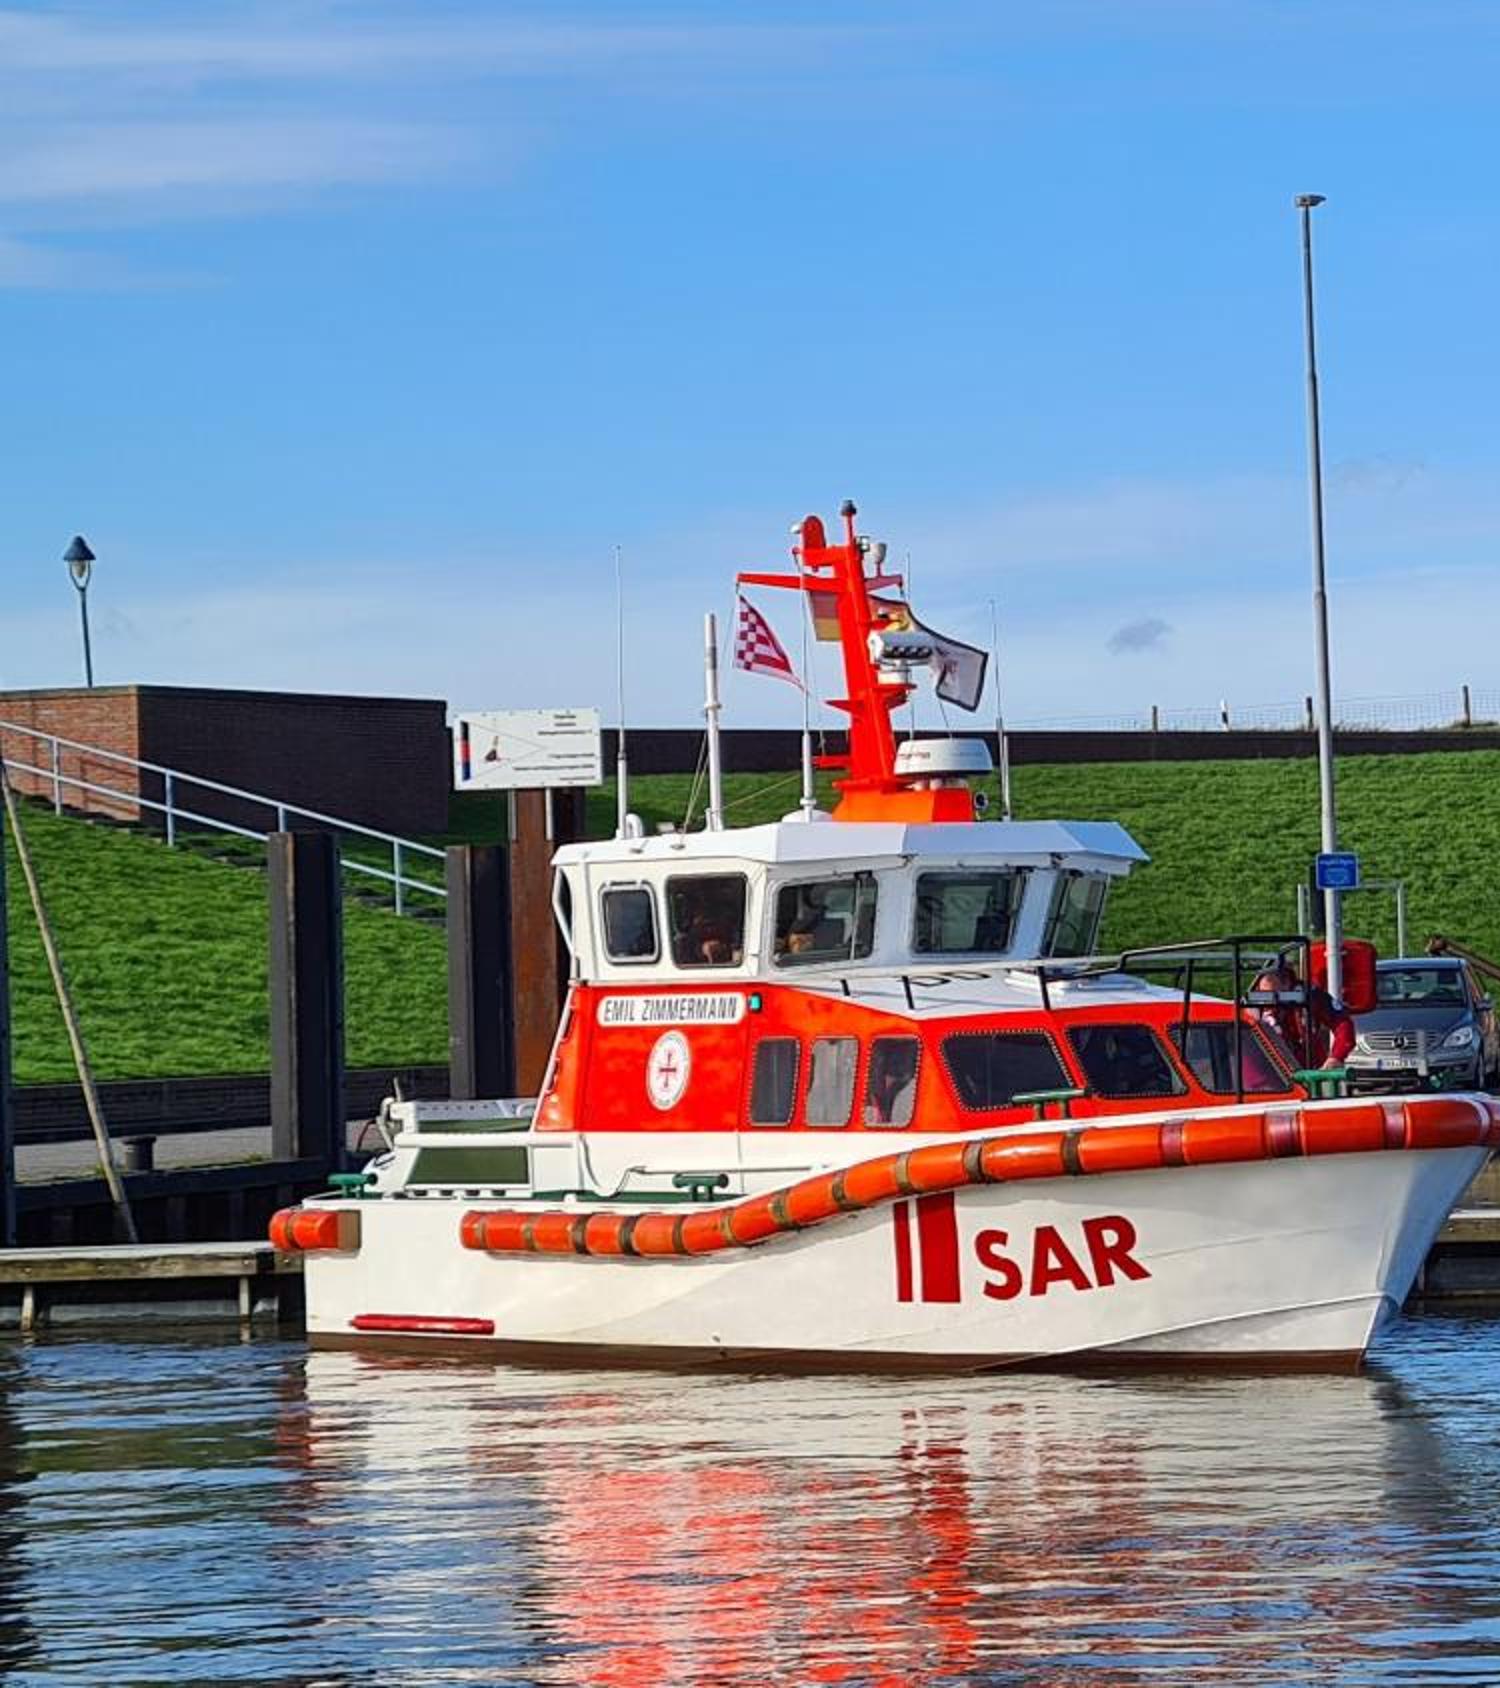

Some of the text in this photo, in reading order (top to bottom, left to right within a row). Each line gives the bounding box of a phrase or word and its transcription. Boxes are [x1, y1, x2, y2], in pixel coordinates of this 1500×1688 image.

[604, 996, 738, 1022] EMIL ZIMMERMANN
[974, 1215, 1152, 1301] SAR
